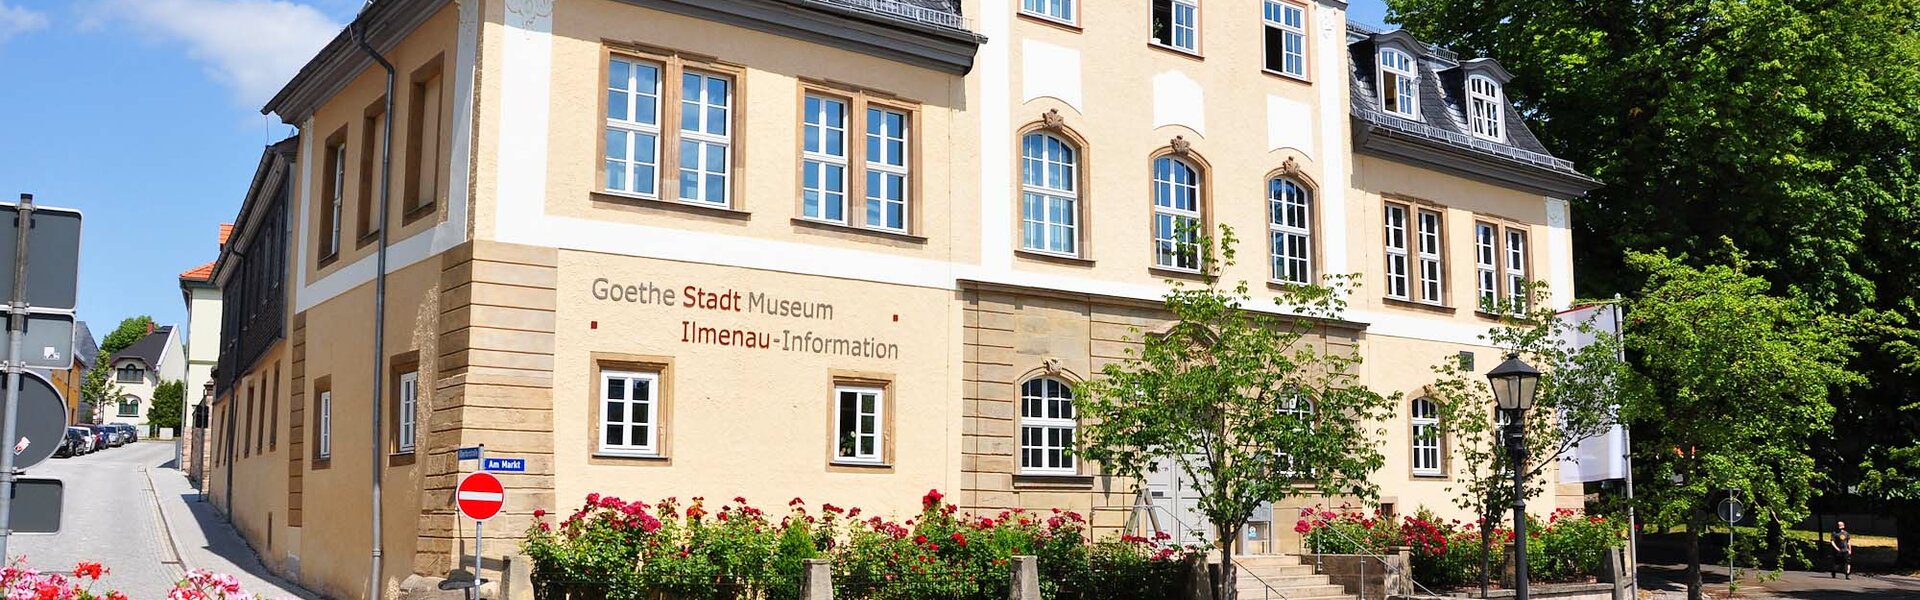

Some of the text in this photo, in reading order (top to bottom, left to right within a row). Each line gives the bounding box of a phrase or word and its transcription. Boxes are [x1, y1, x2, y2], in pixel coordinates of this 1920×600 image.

[592, 278, 833, 320] Goethe Stadt Museum
[681, 321, 898, 359] Ilmenau-Information
[488, 460, 521, 469] Am Markt
